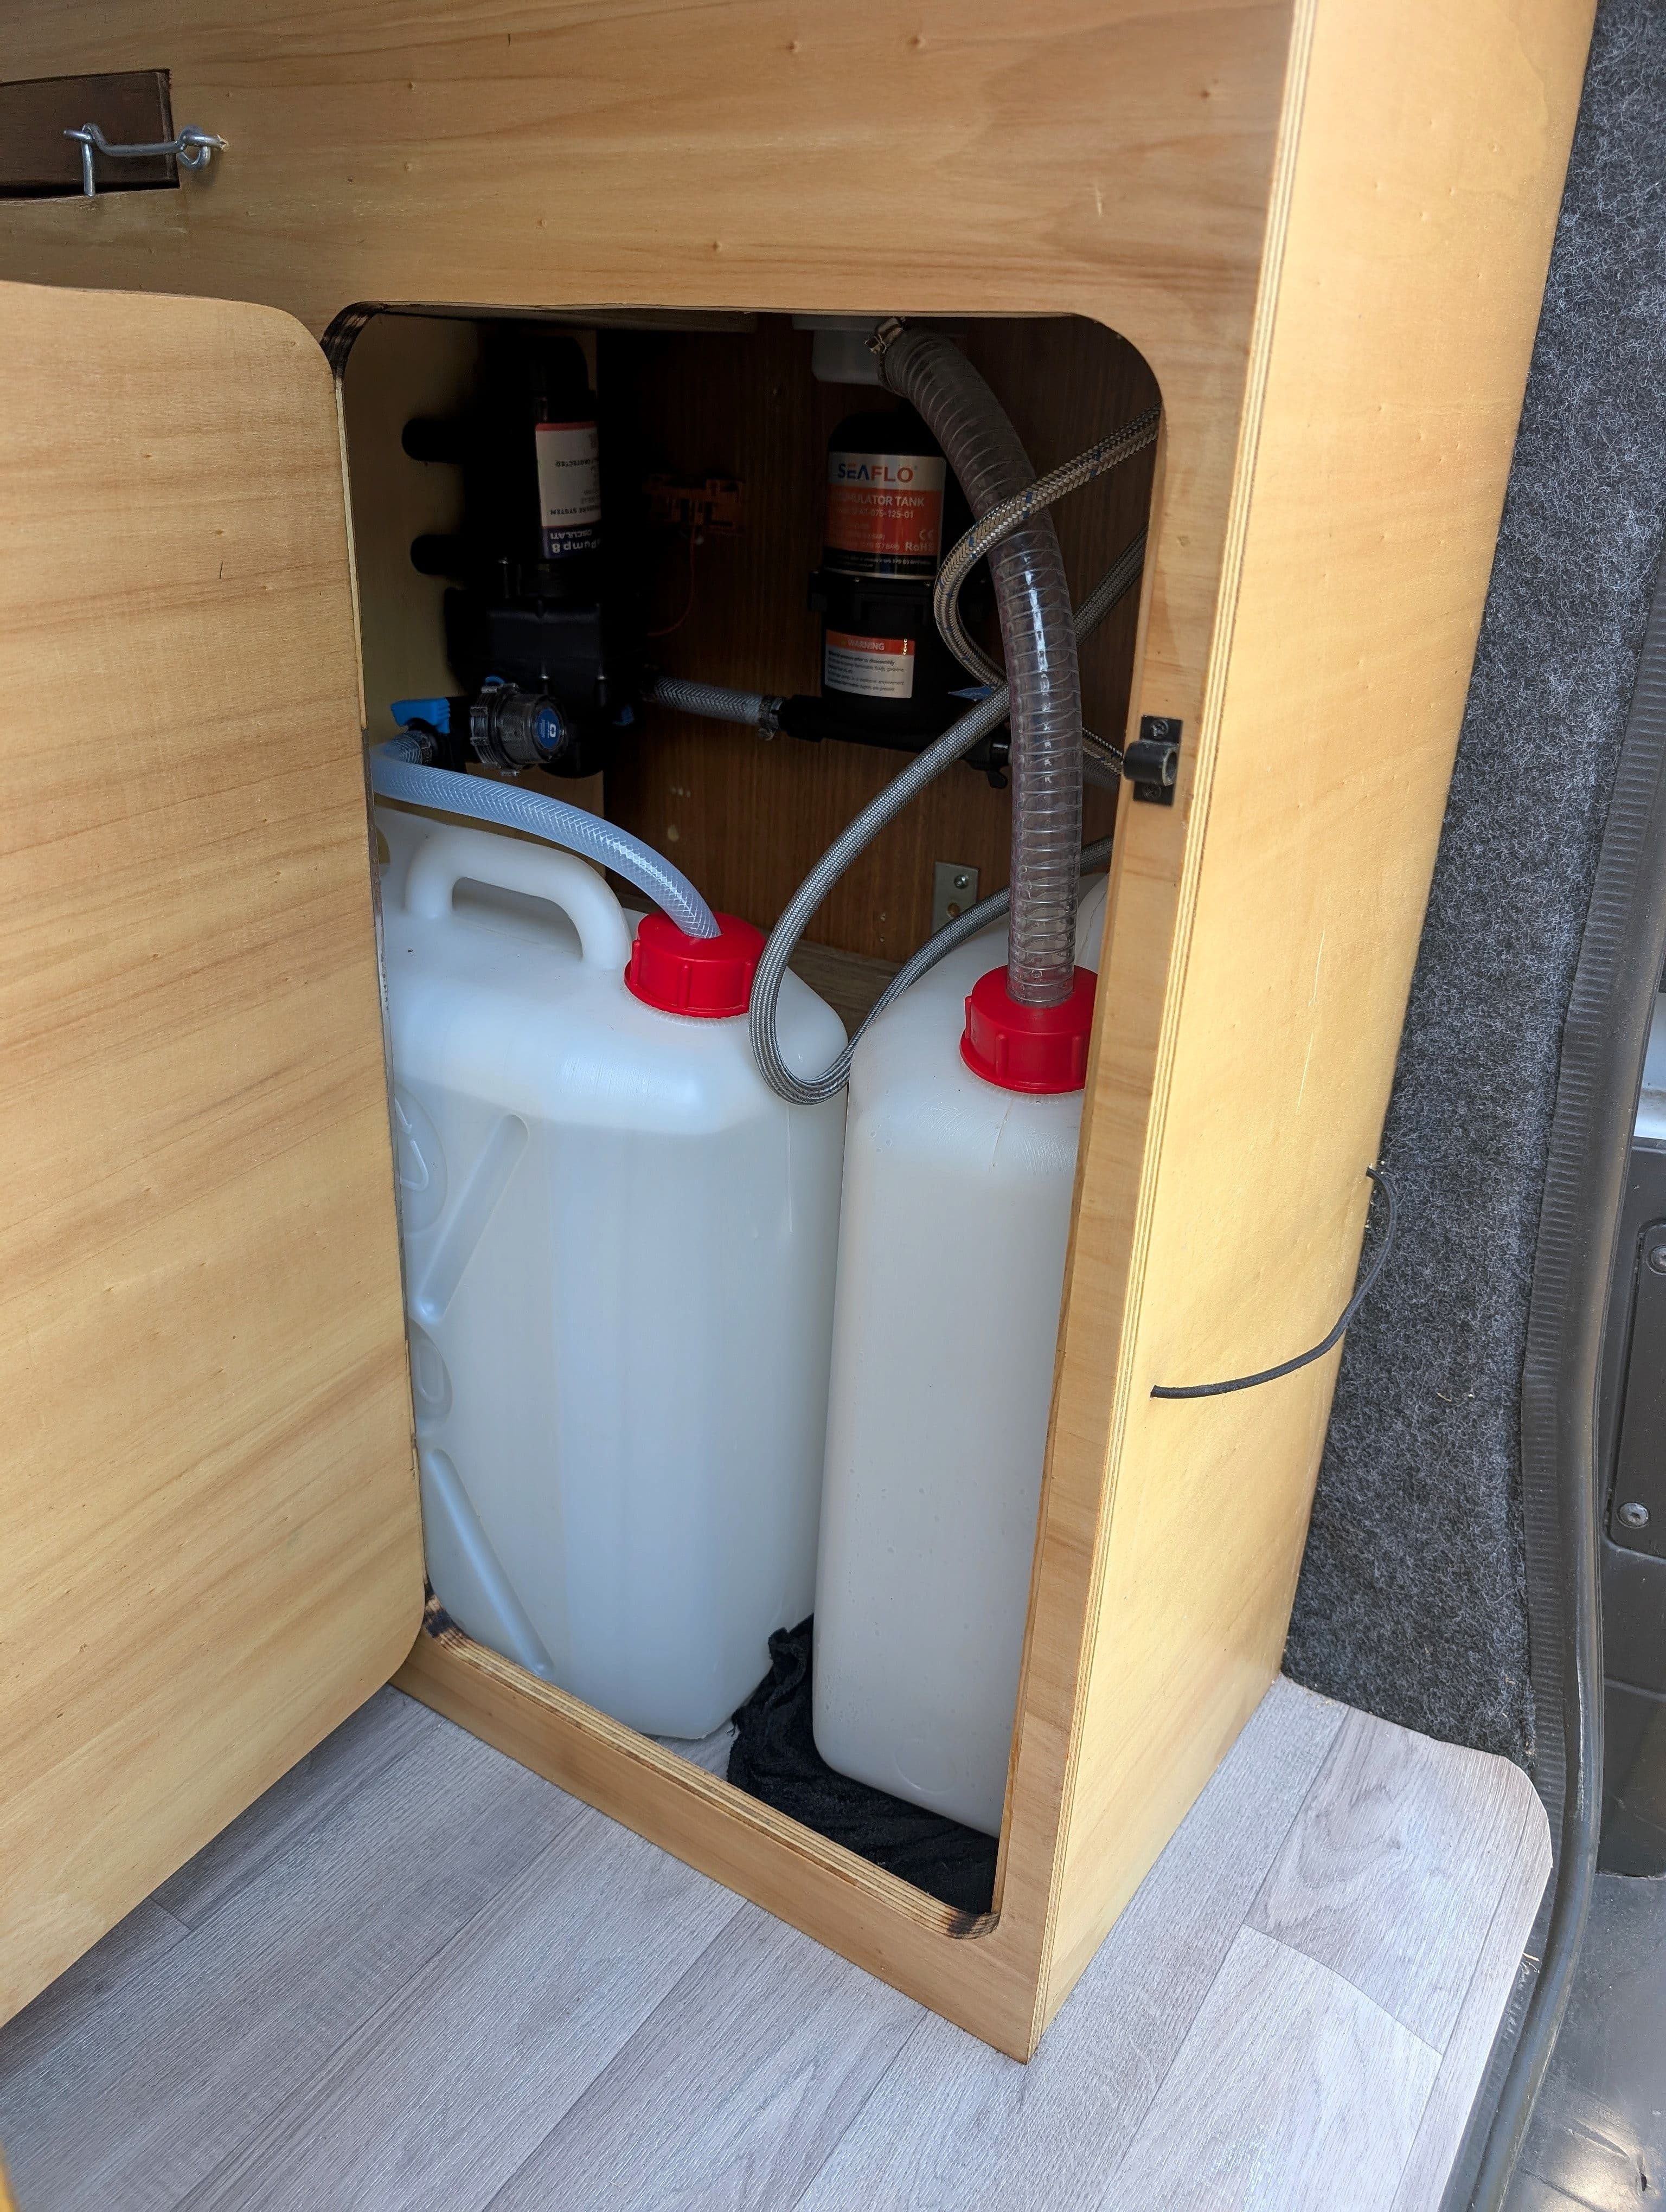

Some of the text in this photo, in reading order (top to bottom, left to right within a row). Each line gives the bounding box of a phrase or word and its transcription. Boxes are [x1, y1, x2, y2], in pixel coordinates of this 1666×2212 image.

[838, 462, 914, 483] SEAFLO
[895, 496, 925, 507] TANK
[550, 529, 592, 540] OSCULATI
[552, 543, 561, 554] 8
[905, 542, 934, 552] RoHS
[848, 639, 885, 651] WARNING
